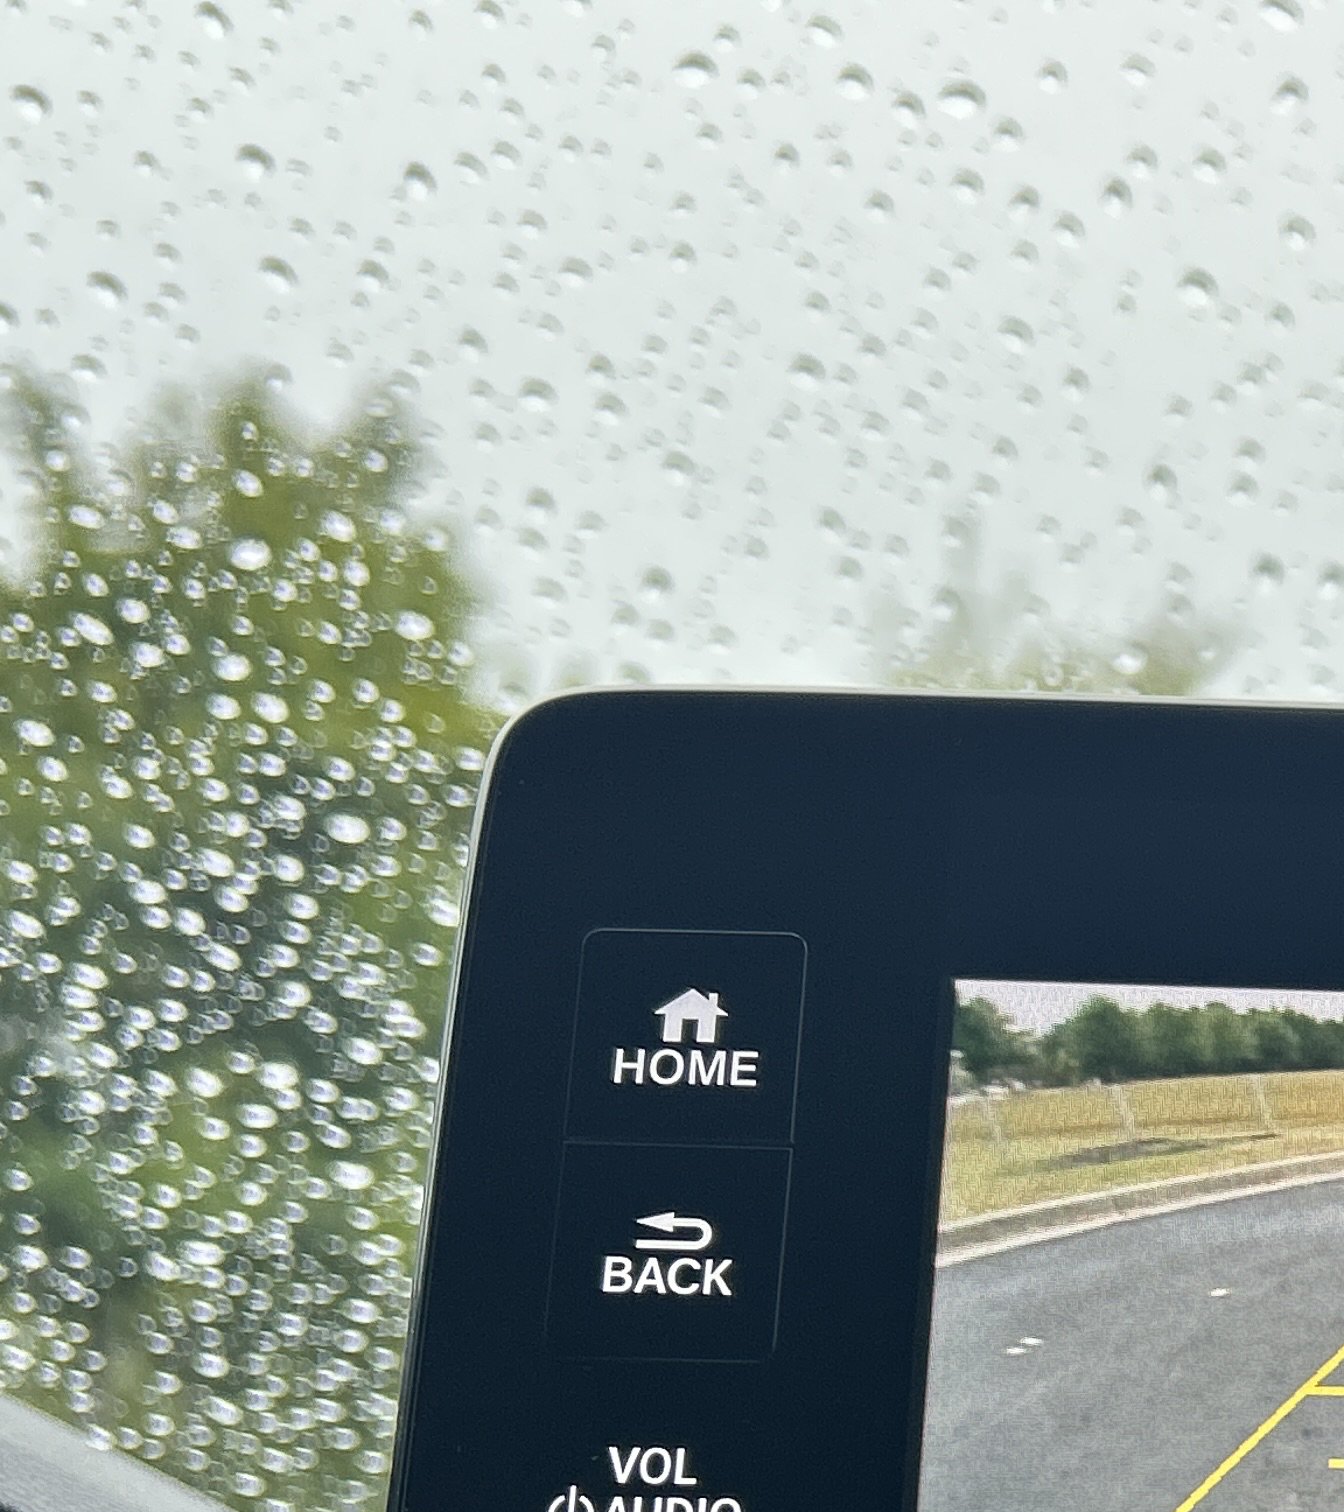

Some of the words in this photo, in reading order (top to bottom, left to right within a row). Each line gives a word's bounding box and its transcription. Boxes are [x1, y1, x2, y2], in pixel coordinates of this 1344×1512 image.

[613, 1048, 759, 1087] HOME
[601, 1255, 733, 1296] BACK
[608, 1446, 698, 1486] VOL
